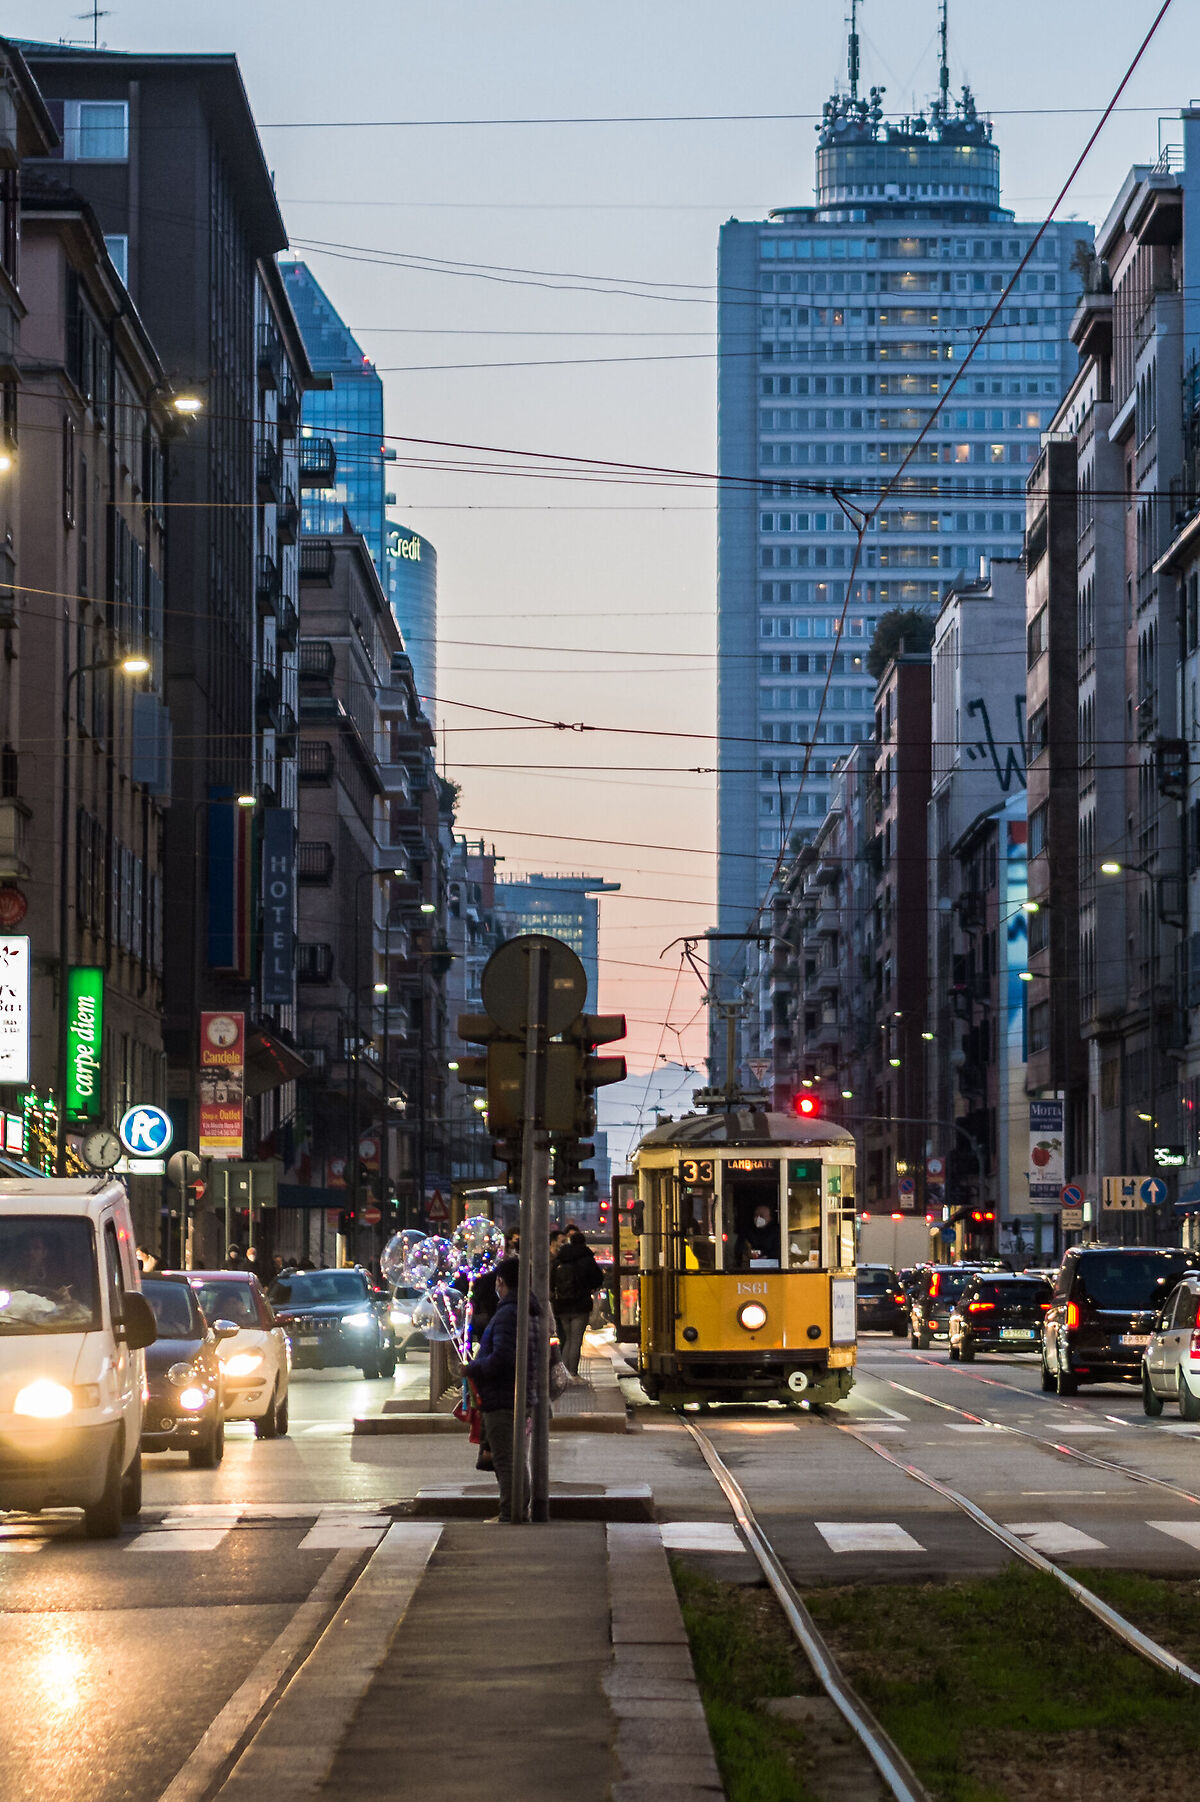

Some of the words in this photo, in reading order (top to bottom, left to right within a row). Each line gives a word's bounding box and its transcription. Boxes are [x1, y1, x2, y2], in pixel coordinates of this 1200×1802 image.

[270, 856, 287, 974] HOTEL
[70, 995, 96, 1042] diem
[203, 1050, 241, 1064] Candele
[73, 1044, 100, 1096] carpe
[219, 1109, 241, 1120] Outlet
[683, 1160, 713, 1183] 33
[728, 1159, 774, 1169] LAMBRATE
[737, 1282, 768, 1295] 1861
